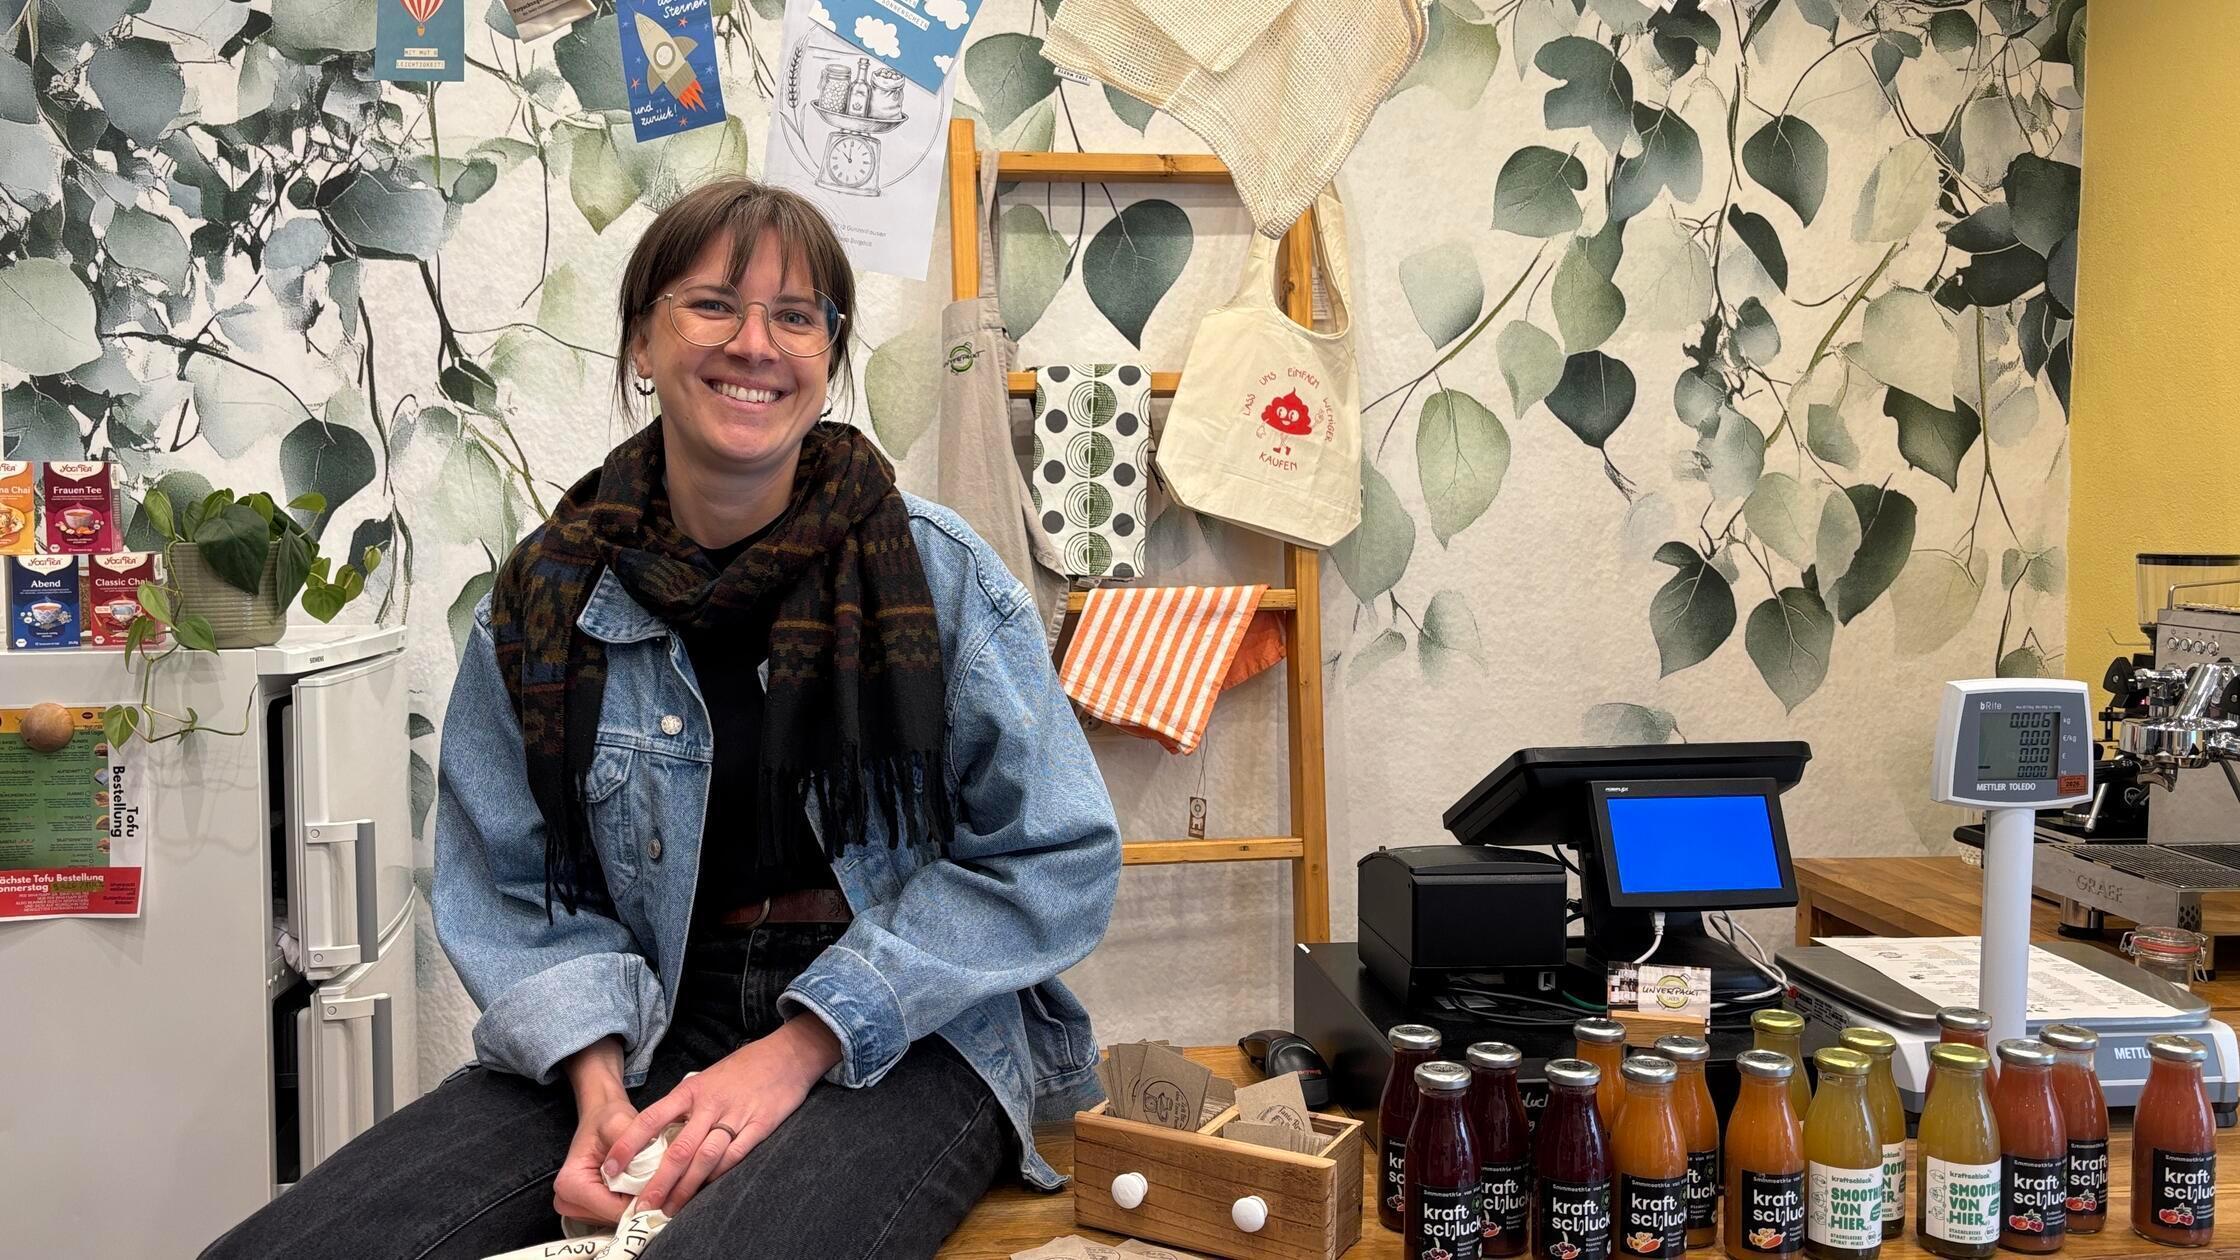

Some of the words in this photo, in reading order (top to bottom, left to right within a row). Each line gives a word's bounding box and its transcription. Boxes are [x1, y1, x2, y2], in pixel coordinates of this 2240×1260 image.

[663, 0, 707, 19] Sternen
[634, 100, 654, 115] und
[641, 103, 678, 126] zurück!
[1259, 371, 1277, 386] UNS
[1243, 393, 1256, 416] LASS
[60, 464, 78, 472] YOGI
[78, 464, 92, 472] TEA
[1259, 451, 1298, 471] KAUFEN
[12, 486, 31, 494] Chai
[53, 486, 85, 494] Frauen
[86, 486, 102, 494] Tee
[28, 558, 48, 566] YOGI
[48, 558, 62, 566] TEA
[104, 557, 122, 565] YOGI
[122, 556, 136, 564] TEA
[31, 580, 61, 588] Abend
[95, 578, 125, 586] Classic
[1976, 782, 2006, 791] METTLER
[2009, 782, 2036, 791] TOLEDO
[111, 766, 126, 838] Bestellung
[127, 806, 139, 837] Tofu
[33, 872, 54, 882] Tofu
[56, 873, 104, 882] Bestellung
[1642, 986, 1707, 997] UNVERPACKT
[2071, 1154, 2108, 1171] kraft
[2014, 1172, 2060, 1190] kraft
[2070, 1170, 2108, 1189] schlu
[2165, 1167, 2210, 1184] kraft
[1687, 1182, 1716, 1199] luck
[1753, 1189, 1798, 1207] kraft
[2164, 1185, 2216, 1204] schluc
[1552, 1197, 1598, 1216] kraft
[1632, 1192, 1677, 1211] kraft
[1831, 1201, 1861, 1216] VON
[1949, 1197, 1980, 1212] VON
[1424, 1203, 1470, 1220] kraft
[1631, 1206, 1687, 1231] schluck
[1753, 1207, 1804, 1227] schluc
[1949, 1211, 1985, 1226] HIER
[1424, 1216, 1482, 1240] schluck
[1552, 1211, 1611, 1236] schluck
[1830, 1216, 1867, 1231] HIER
